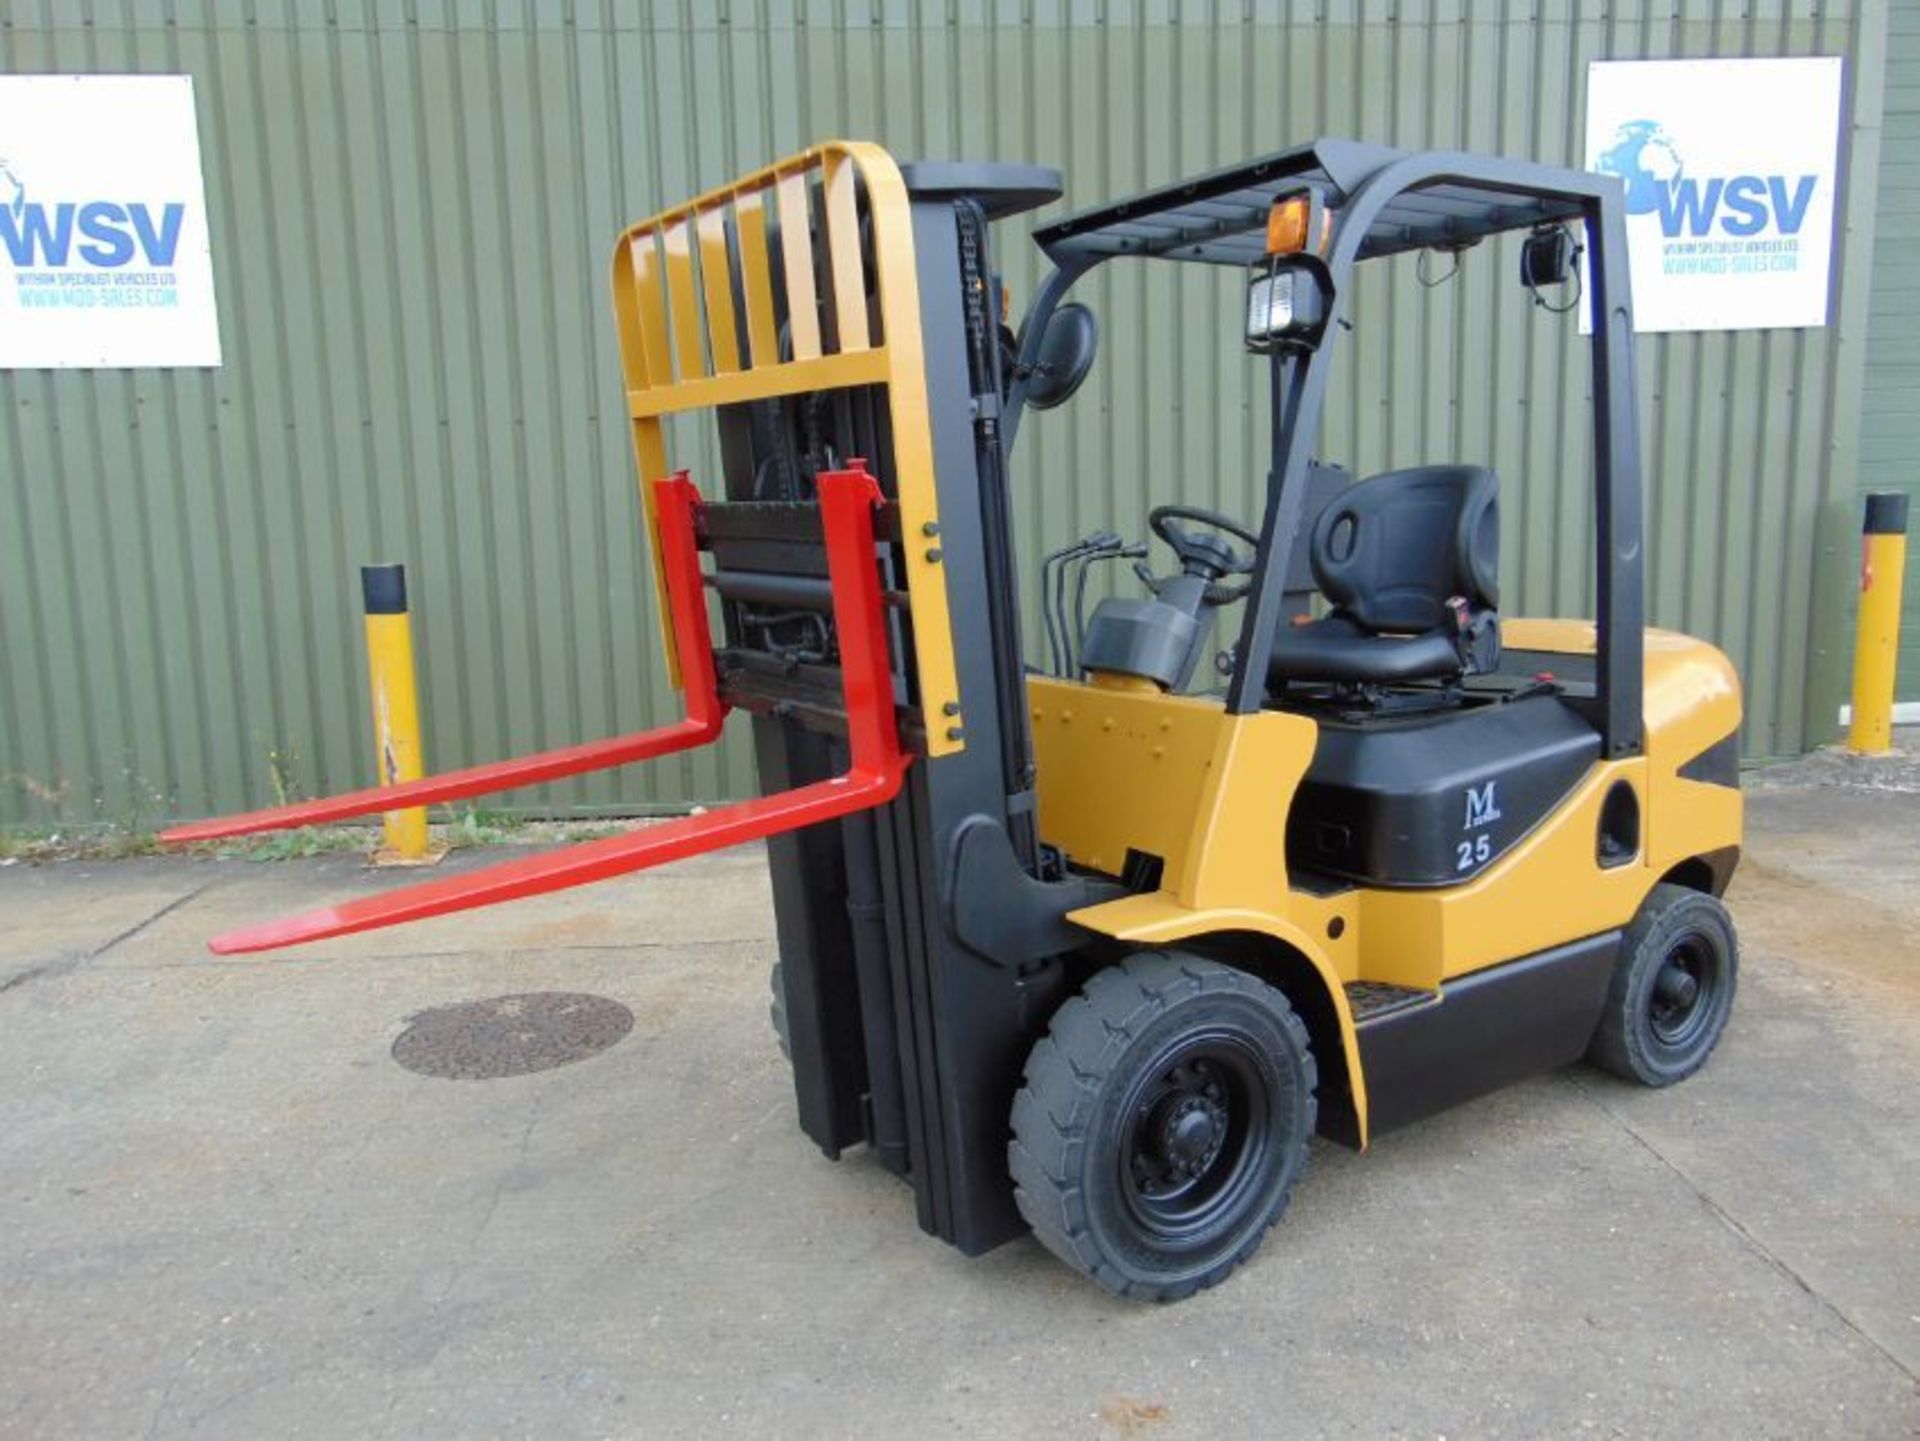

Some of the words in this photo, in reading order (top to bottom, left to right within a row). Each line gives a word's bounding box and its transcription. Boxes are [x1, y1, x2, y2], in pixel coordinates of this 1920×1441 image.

[0, 201, 185, 267] WSV
[1654, 175, 1818, 237] WSV
[1456, 834, 1490, 870] 25
